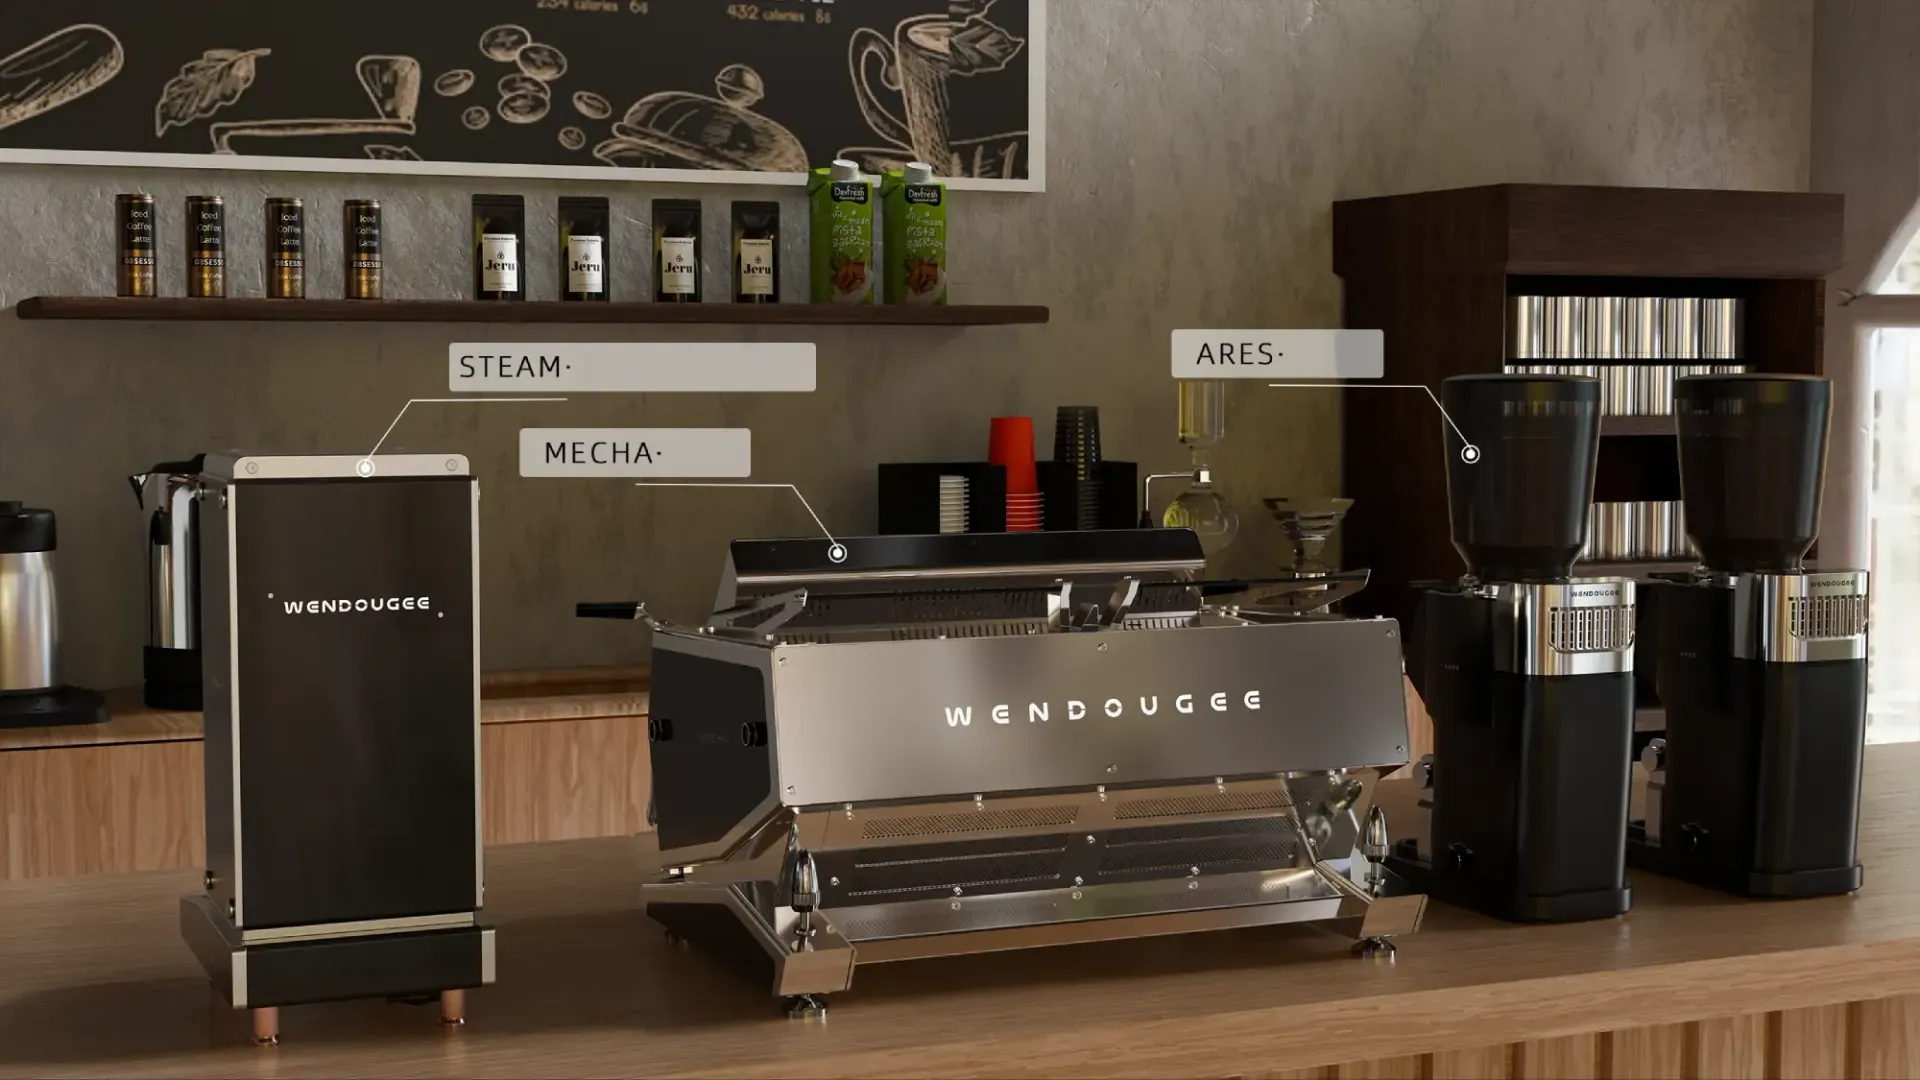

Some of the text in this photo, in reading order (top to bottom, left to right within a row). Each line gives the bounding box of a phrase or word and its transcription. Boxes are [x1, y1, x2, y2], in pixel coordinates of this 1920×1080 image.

[726, 4, 759, 20] 432
[131, 210, 149, 218] Iced
[281, 213, 298, 221] Iced
[359, 215, 376, 223] Iced
[126, 222, 152, 231] Coffee
[196, 224, 222, 232] Coffee
[276, 226, 301, 234] Coffee
[355, 228, 380, 236] Coffee
[199, 236, 220, 244] Latte
[280, 238, 300, 246] Latte
[358, 239, 378, 247] Latte
[485, 259, 515, 271] Jeru
[571, 260, 600, 272] Jeru
[664, 262, 693, 273] Jeru
[743, 264, 771, 275] Jeru
[283, 596, 430, 615] WENDOUGEE
[944, 690, 1260, 728] WENDOUGEE
